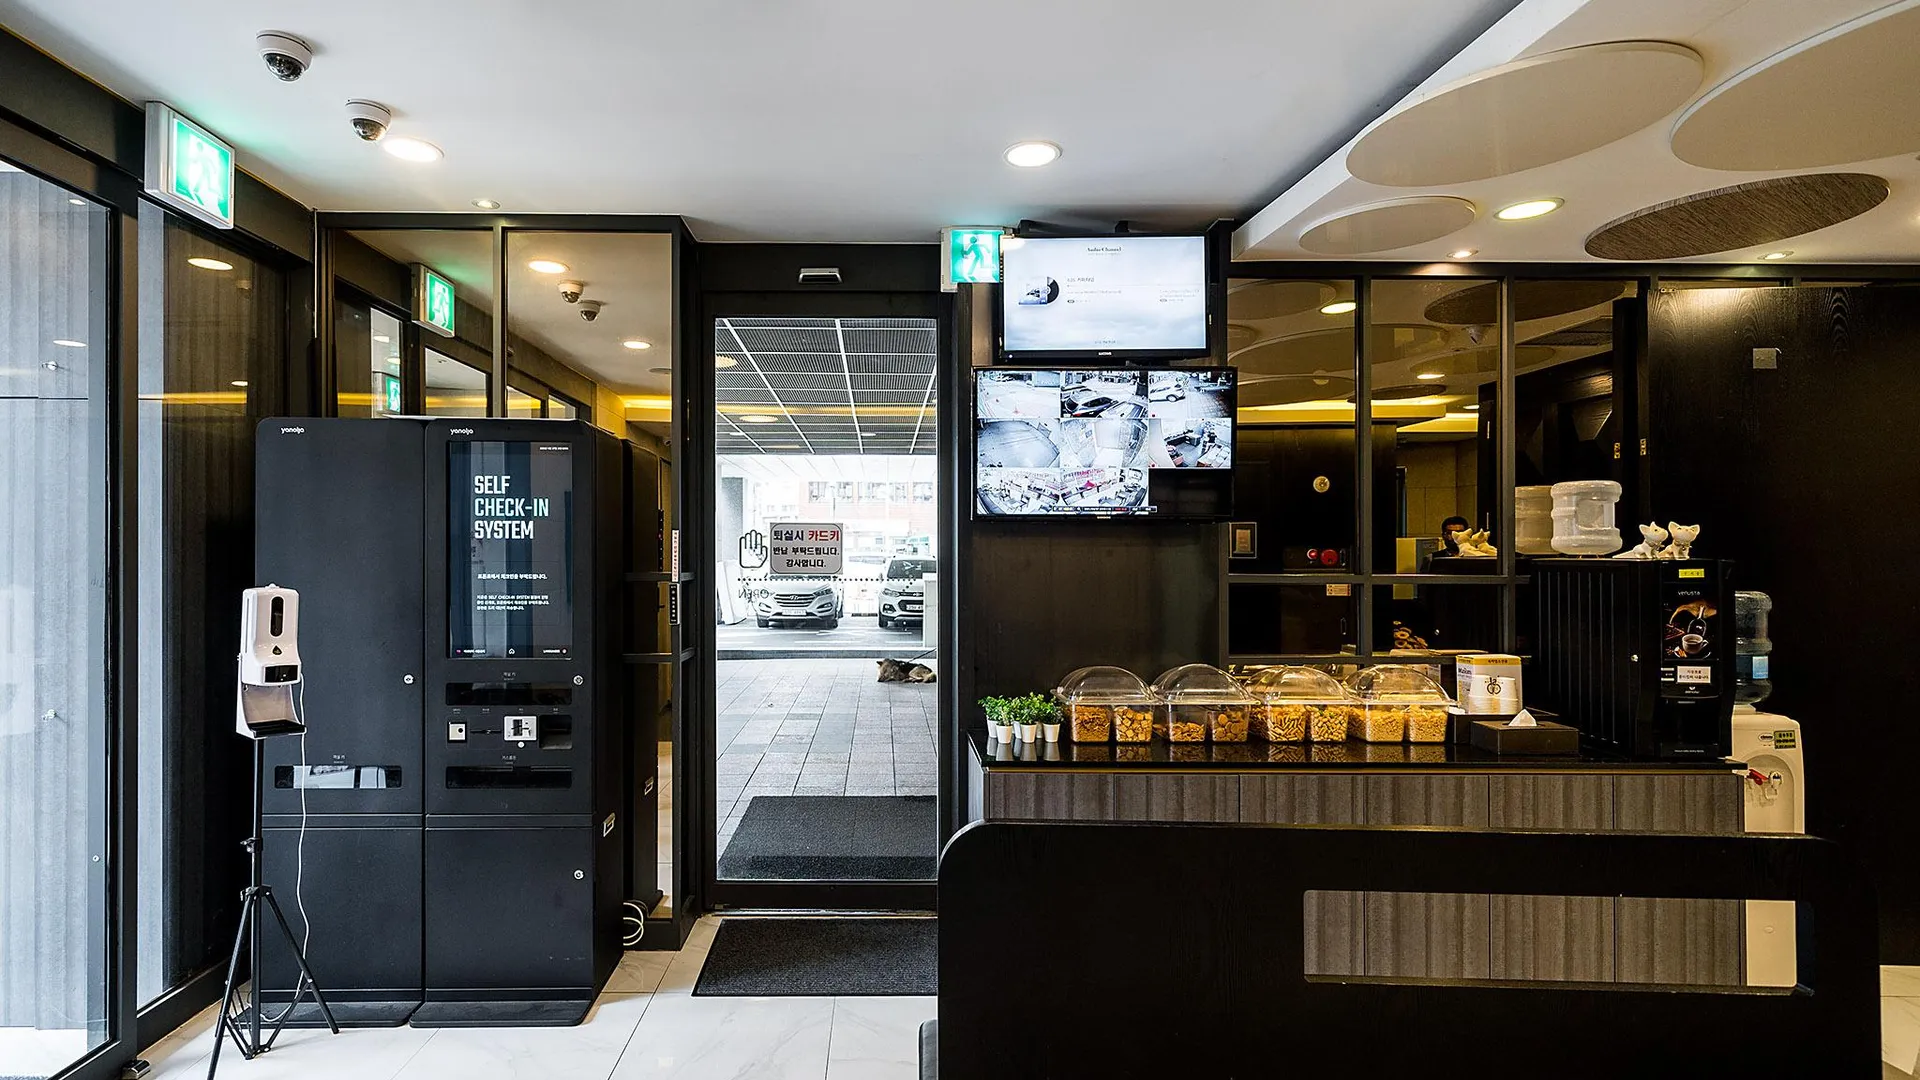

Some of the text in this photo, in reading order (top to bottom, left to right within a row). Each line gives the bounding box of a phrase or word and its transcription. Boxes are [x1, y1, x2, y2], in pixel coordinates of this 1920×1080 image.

[474, 475, 511, 495] SELF
[474, 497, 549, 517] CHECK-IN
[474, 520, 534, 540] SYSTEM
[773, 530, 840, 542] 퇴실시 카드키
[773, 547, 840, 556] 반납 부탁드립니다.
[786, 559, 827, 568] 감사합니다.
